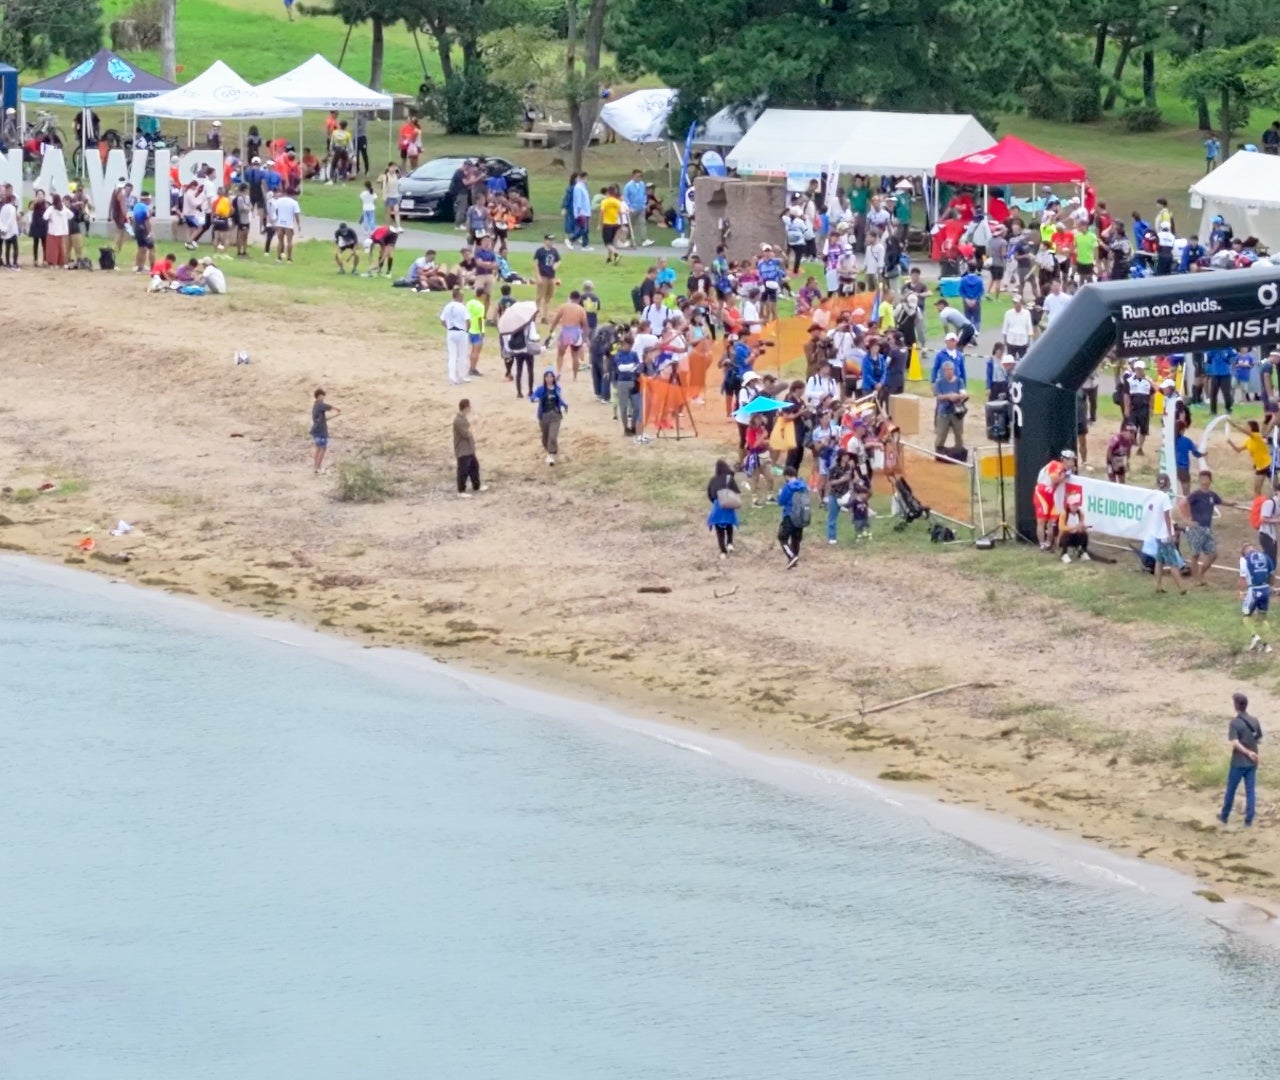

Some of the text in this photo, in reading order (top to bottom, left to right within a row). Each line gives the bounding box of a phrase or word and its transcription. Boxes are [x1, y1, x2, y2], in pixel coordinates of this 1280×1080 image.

[1122, 297, 1222, 319] Run on clouds.
[1123, 326, 1189, 340] LAKE BIWA
[1123, 335, 1190, 348] TRIATHLON
[1088, 495, 1144, 521] HEIWADO
